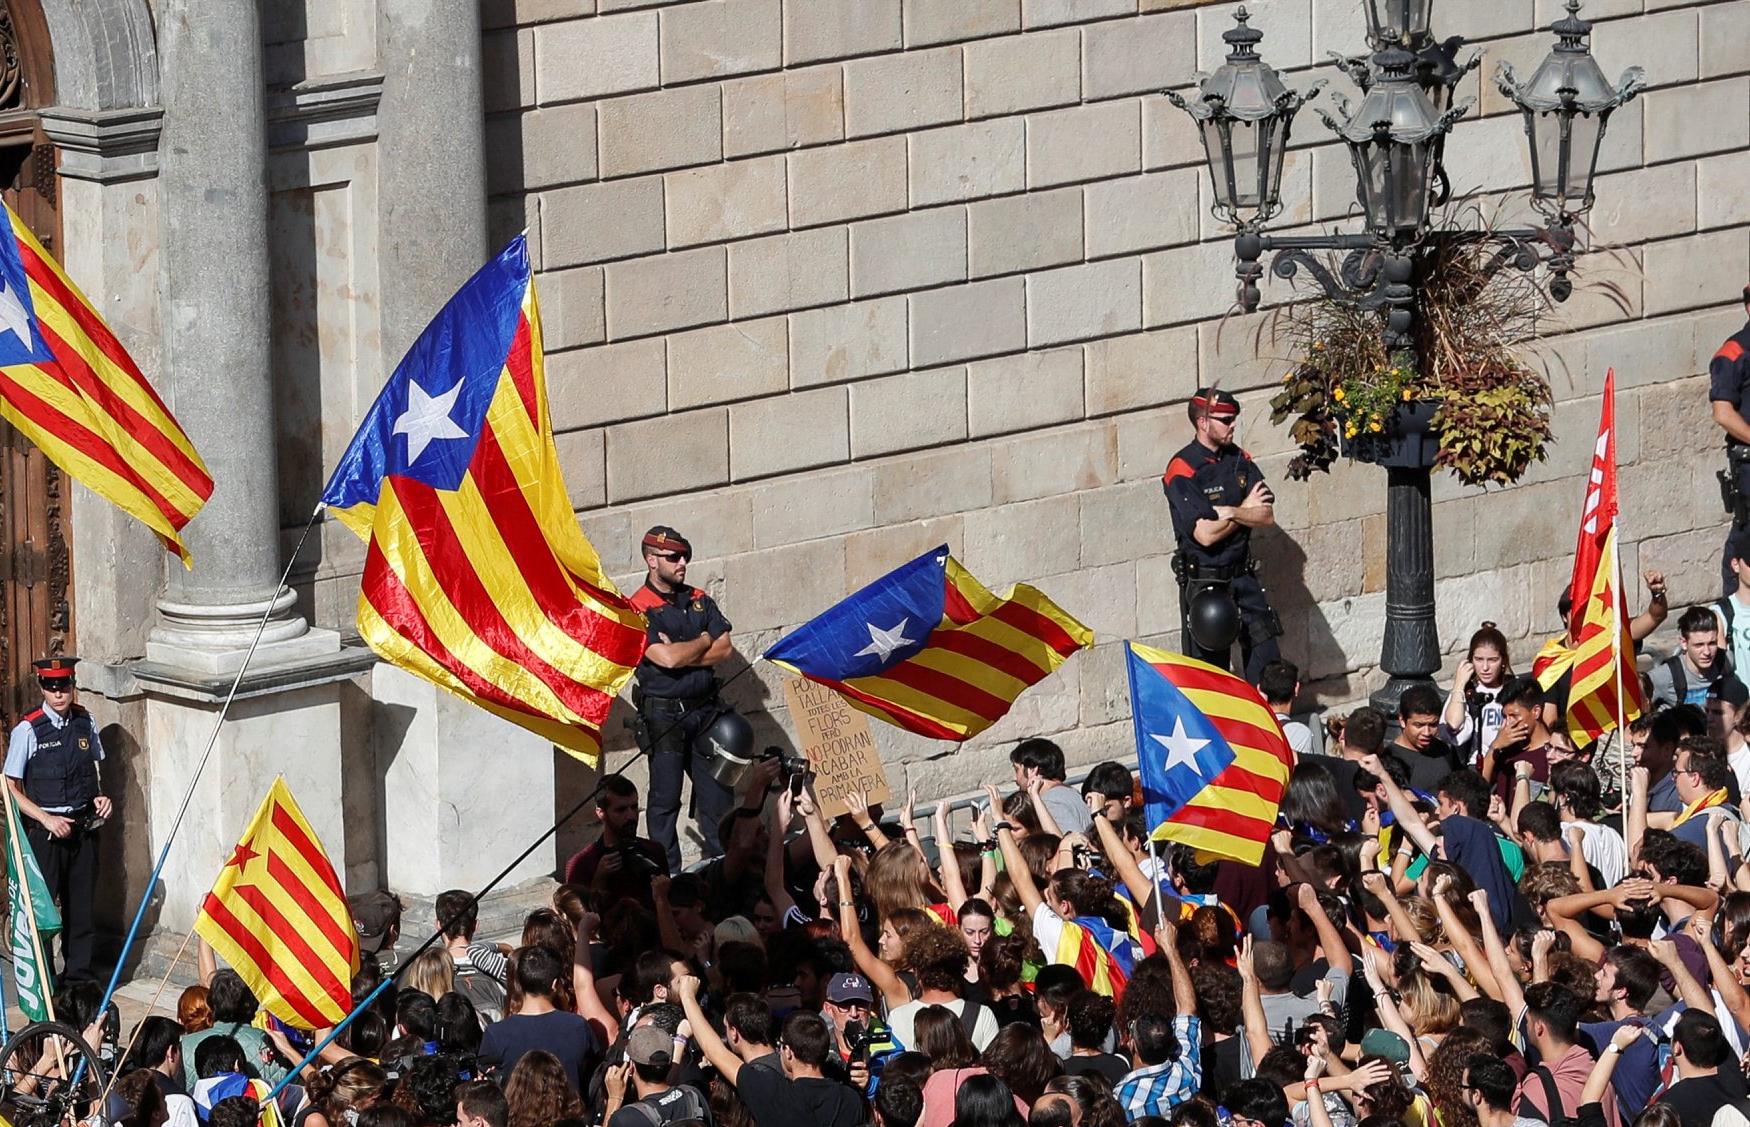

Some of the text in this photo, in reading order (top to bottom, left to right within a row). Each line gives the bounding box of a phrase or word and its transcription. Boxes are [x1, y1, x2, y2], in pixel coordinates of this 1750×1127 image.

[831, 700, 848, 710] LES
[808, 708, 851, 735] FLORS
[805, 730, 871, 763] NO PODRAN
[814, 751, 868, 776] ACABAR
[831, 768, 863, 784] AMB LA
[13, 886, 40, 1010] JOVE
